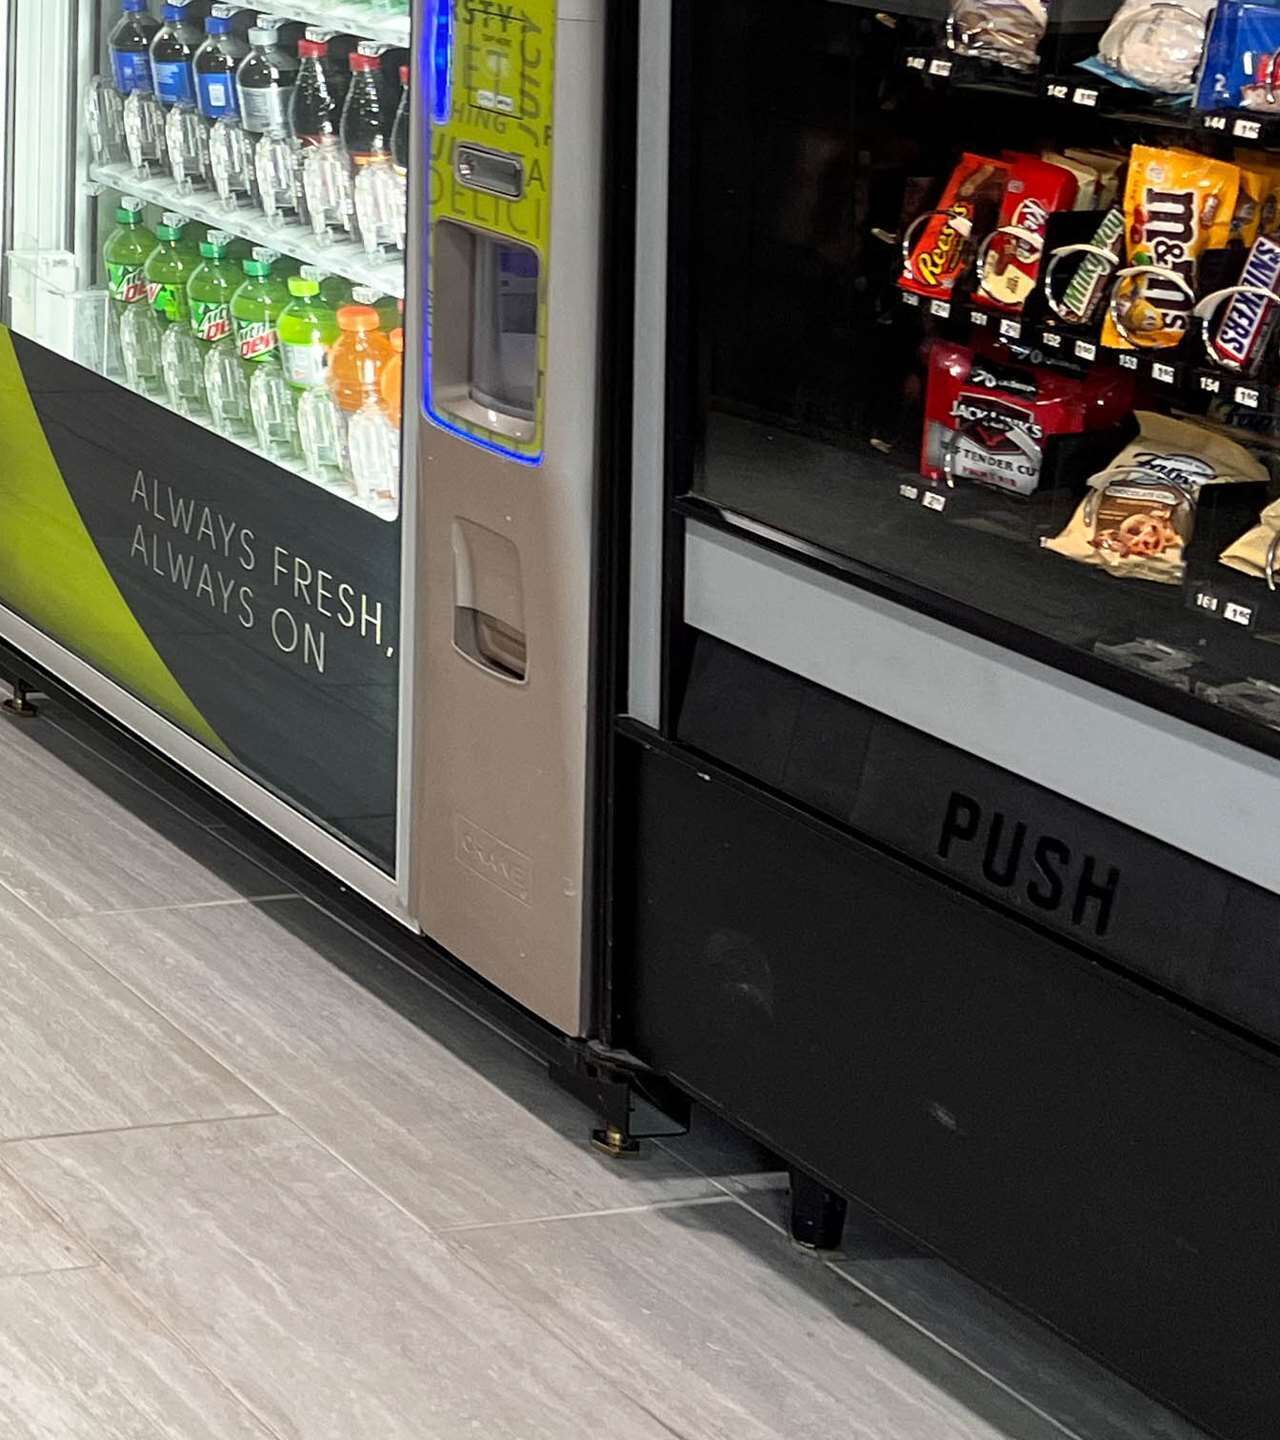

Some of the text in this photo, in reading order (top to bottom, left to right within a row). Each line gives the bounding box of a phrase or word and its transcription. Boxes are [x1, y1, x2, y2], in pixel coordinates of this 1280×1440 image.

[1047, 84, 1068, 99] 142
[1203, 116, 1226, 130] 144
[971, 369, 997, 388] 70
[1199, 376, 1220, 394] 154
[963, 448, 1014, 472] TENDER
[130, 468, 394, 658] ALWAYS FRESH,
[130, 523, 325, 673] ALWAYS ON
[937, 791, 1120, 937] PUSH
